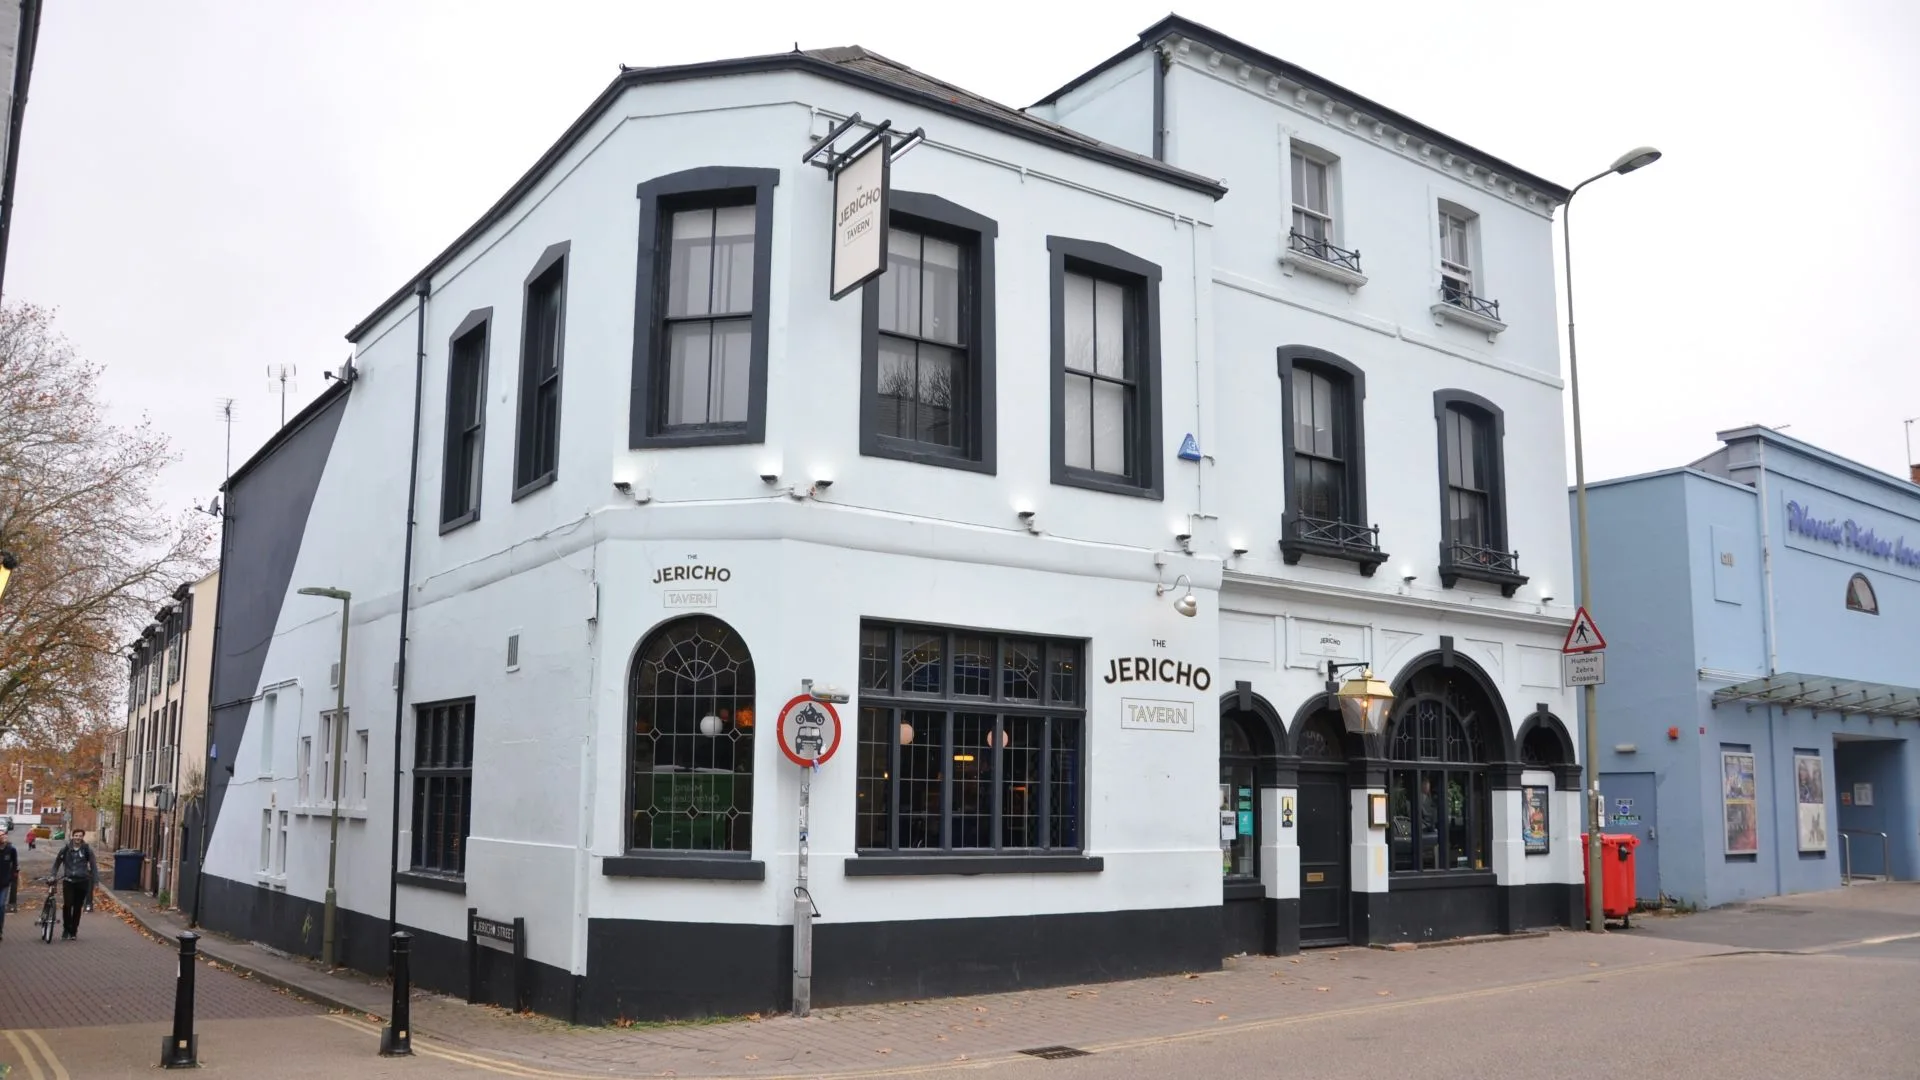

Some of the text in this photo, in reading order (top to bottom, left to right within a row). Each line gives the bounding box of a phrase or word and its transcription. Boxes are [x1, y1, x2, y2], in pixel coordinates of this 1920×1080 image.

[838, 187, 881, 227] JERICHO
[846, 217, 870, 241] TAVERN
[652, 565, 731, 584] JERICHO
[668, 592, 713, 604] TAVERN
[1151, 638, 1167, 648] THE
[1320, 637, 1341, 646] JERICHO
[1571, 656, 1598, 664] Humped
[1103, 656, 1211, 692] JERICHO
[1127, 704, 1188, 725] TAVERN
[477, 919, 515, 940] JERICHO STREET
